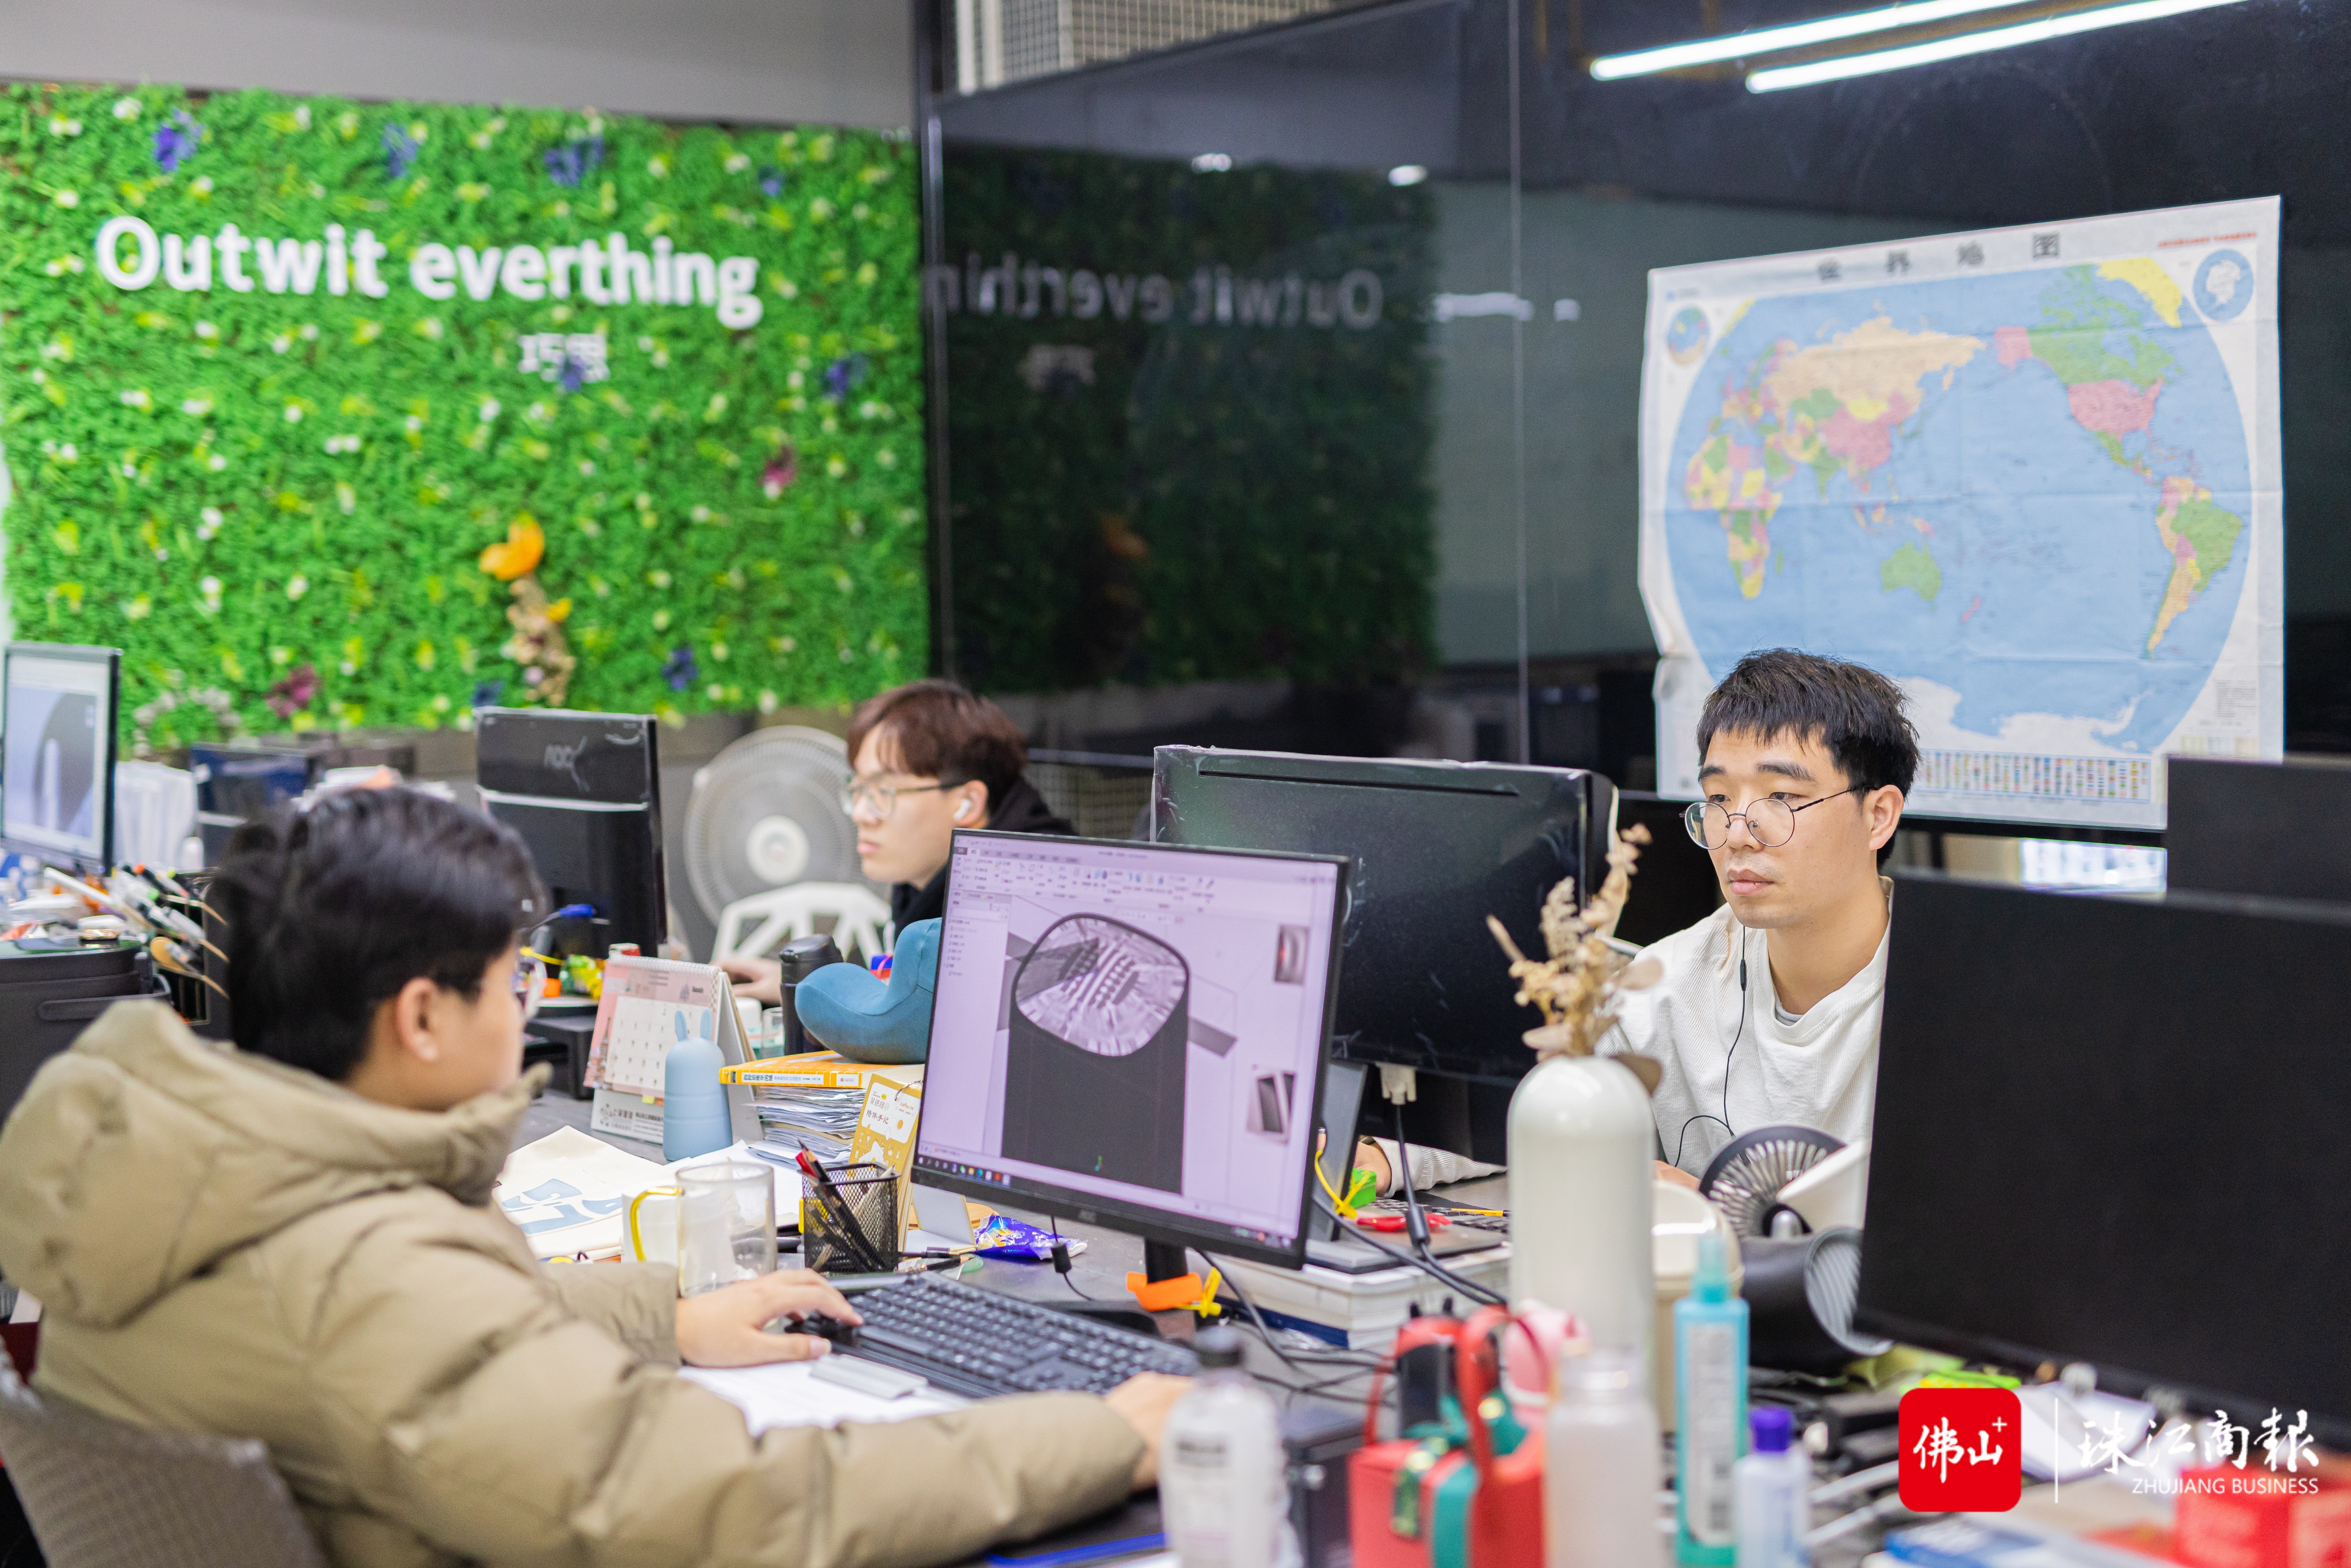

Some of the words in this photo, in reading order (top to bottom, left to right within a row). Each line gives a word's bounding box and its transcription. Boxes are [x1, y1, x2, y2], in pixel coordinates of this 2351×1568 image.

[97, 216, 388, 297] Outwit
[410, 233, 763, 328] everthing
[866, 1110, 889, 1124] 陪伴手记
